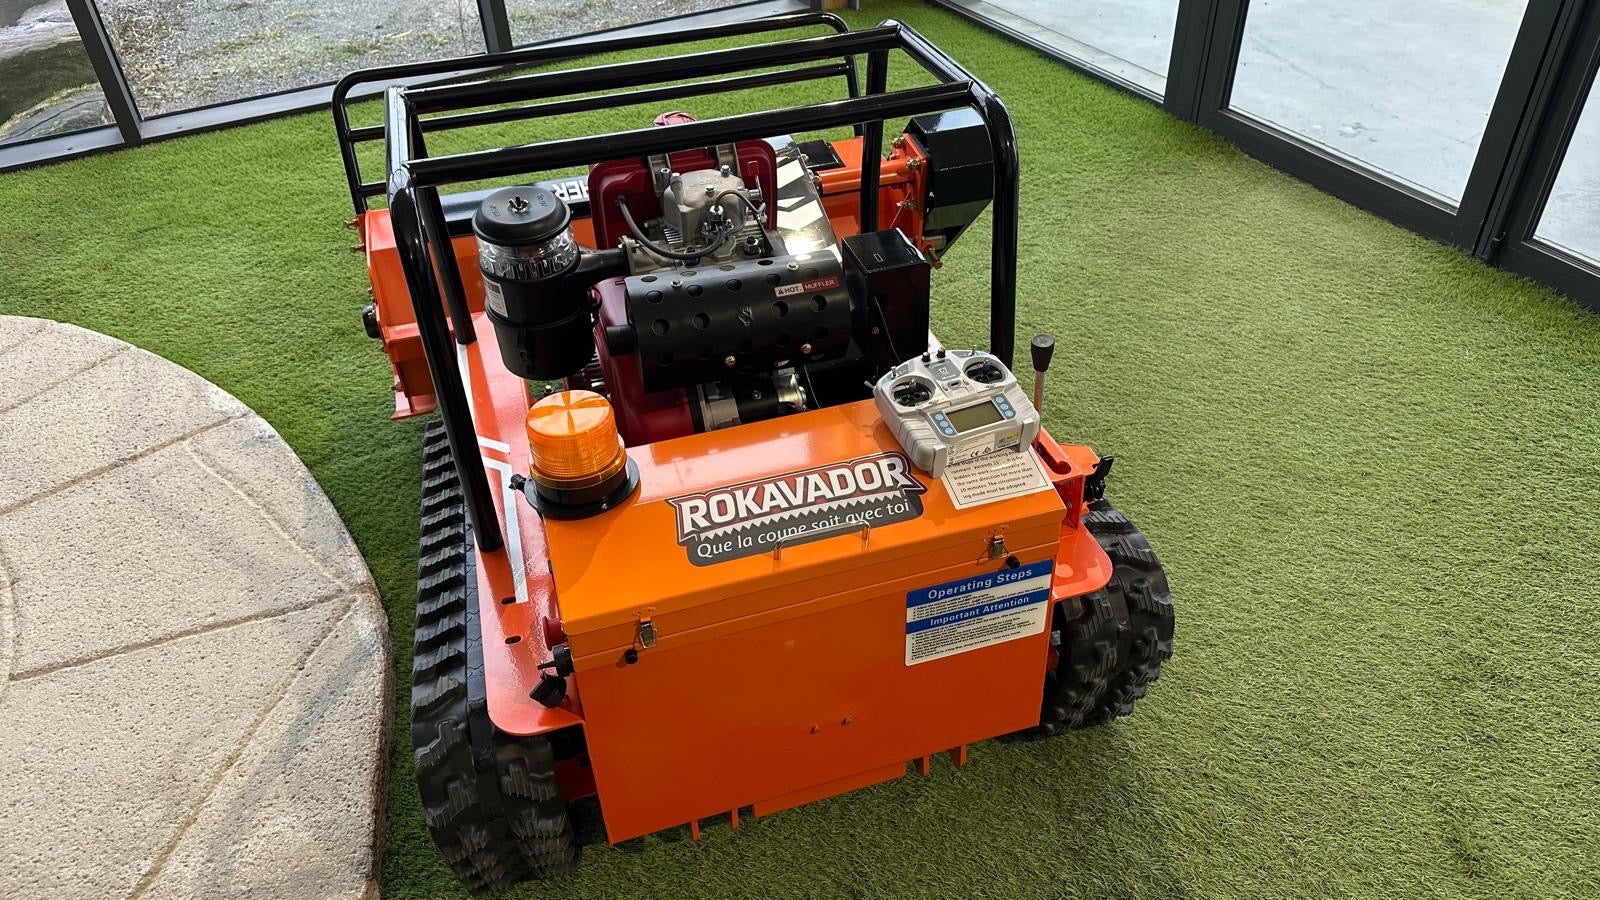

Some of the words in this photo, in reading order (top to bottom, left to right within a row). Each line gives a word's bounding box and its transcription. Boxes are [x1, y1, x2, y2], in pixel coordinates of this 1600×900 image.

[804, 279, 835, 290] MUFFLER
[683, 456, 912, 535] ROKAVADOR
[697, 540, 733, 558] Que
[737, 534, 753, 549] la
[811, 515, 841, 530] soit
[845, 507, 883, 525] avec
[886, 498, 910, 515] toi
[928, 578, 992, 600] Operating
[996, 569, 1032, 583] Steps
[930, 608, 979, 626] Important
[982, 596, 1029, 613] Attention
